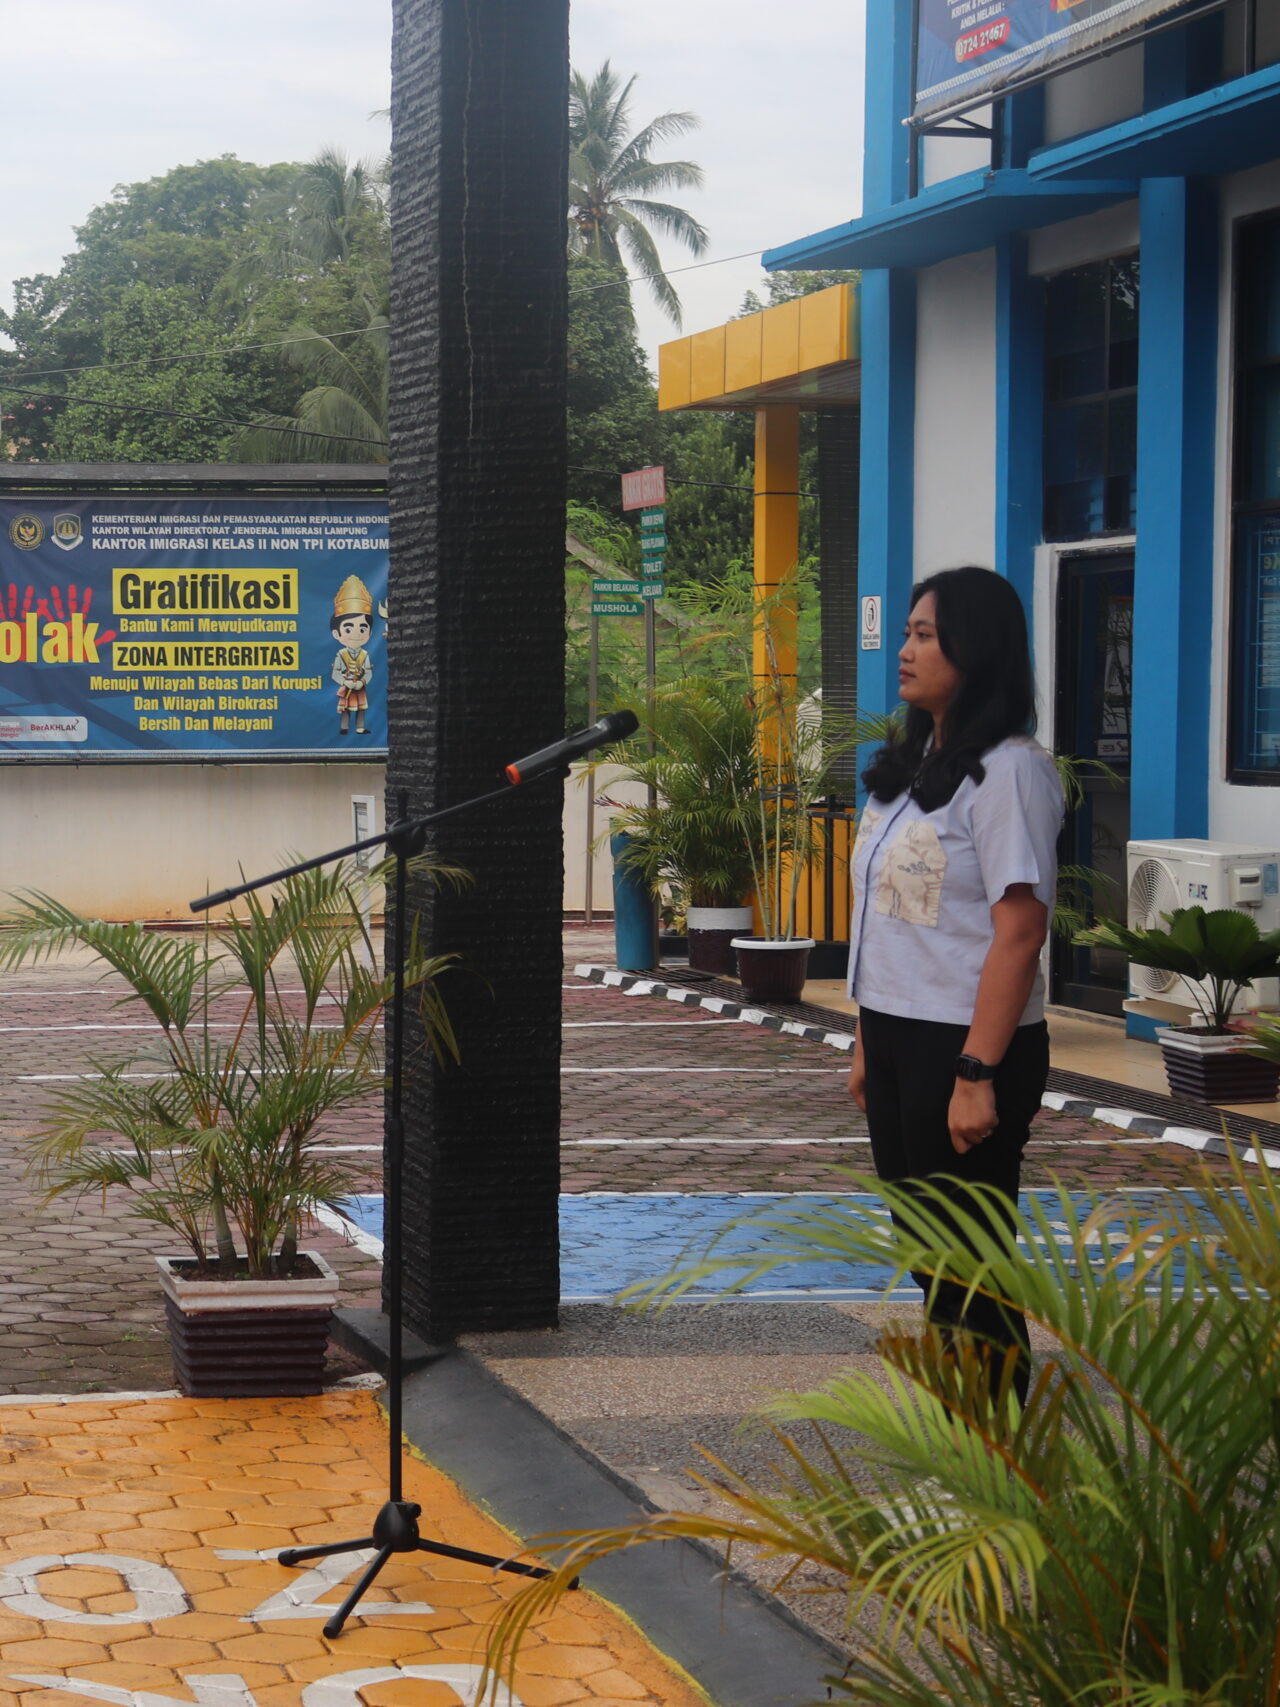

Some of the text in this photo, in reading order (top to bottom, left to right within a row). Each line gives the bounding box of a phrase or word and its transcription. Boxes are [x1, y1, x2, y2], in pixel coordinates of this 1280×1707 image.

[959, 23, 1006, 55] 0724 21467
[91, 515, 390, 524] KEMENTERIAN IMIGRASI DAN PEMASYARAKATAN REPUBLIK INDONE
[91, 526, 368, 535] KANTOR WILAYAH DIREKTORAT JENDERAL IMIGRASI LAMPUNG
[91, 538, 389, 550] KANTOR IMIGRASI KELAS II NON TPI KOTABUM
[642, 561, 662, 574] TOILET
[119, 573, 291, 610] Gratifikasi
[613, 583, 639, 592] BELAKANG
[642, 585, 662, 596] KELUAR
[593, 604, 638, 613] MUSHOLA
[119, 618, 297, 634] Bantu Kami Mewujudkanya
[116, 645, 295, 667] ZONA INTERGRITAS
[90, 675, 323, 692] Menuju Wilayah Bebas Dari Korupsi
[133, 695, 279, 712] Dan Wilayah Birokrasi
[139, 716, 273, 732] Bersih Dan Melayani
